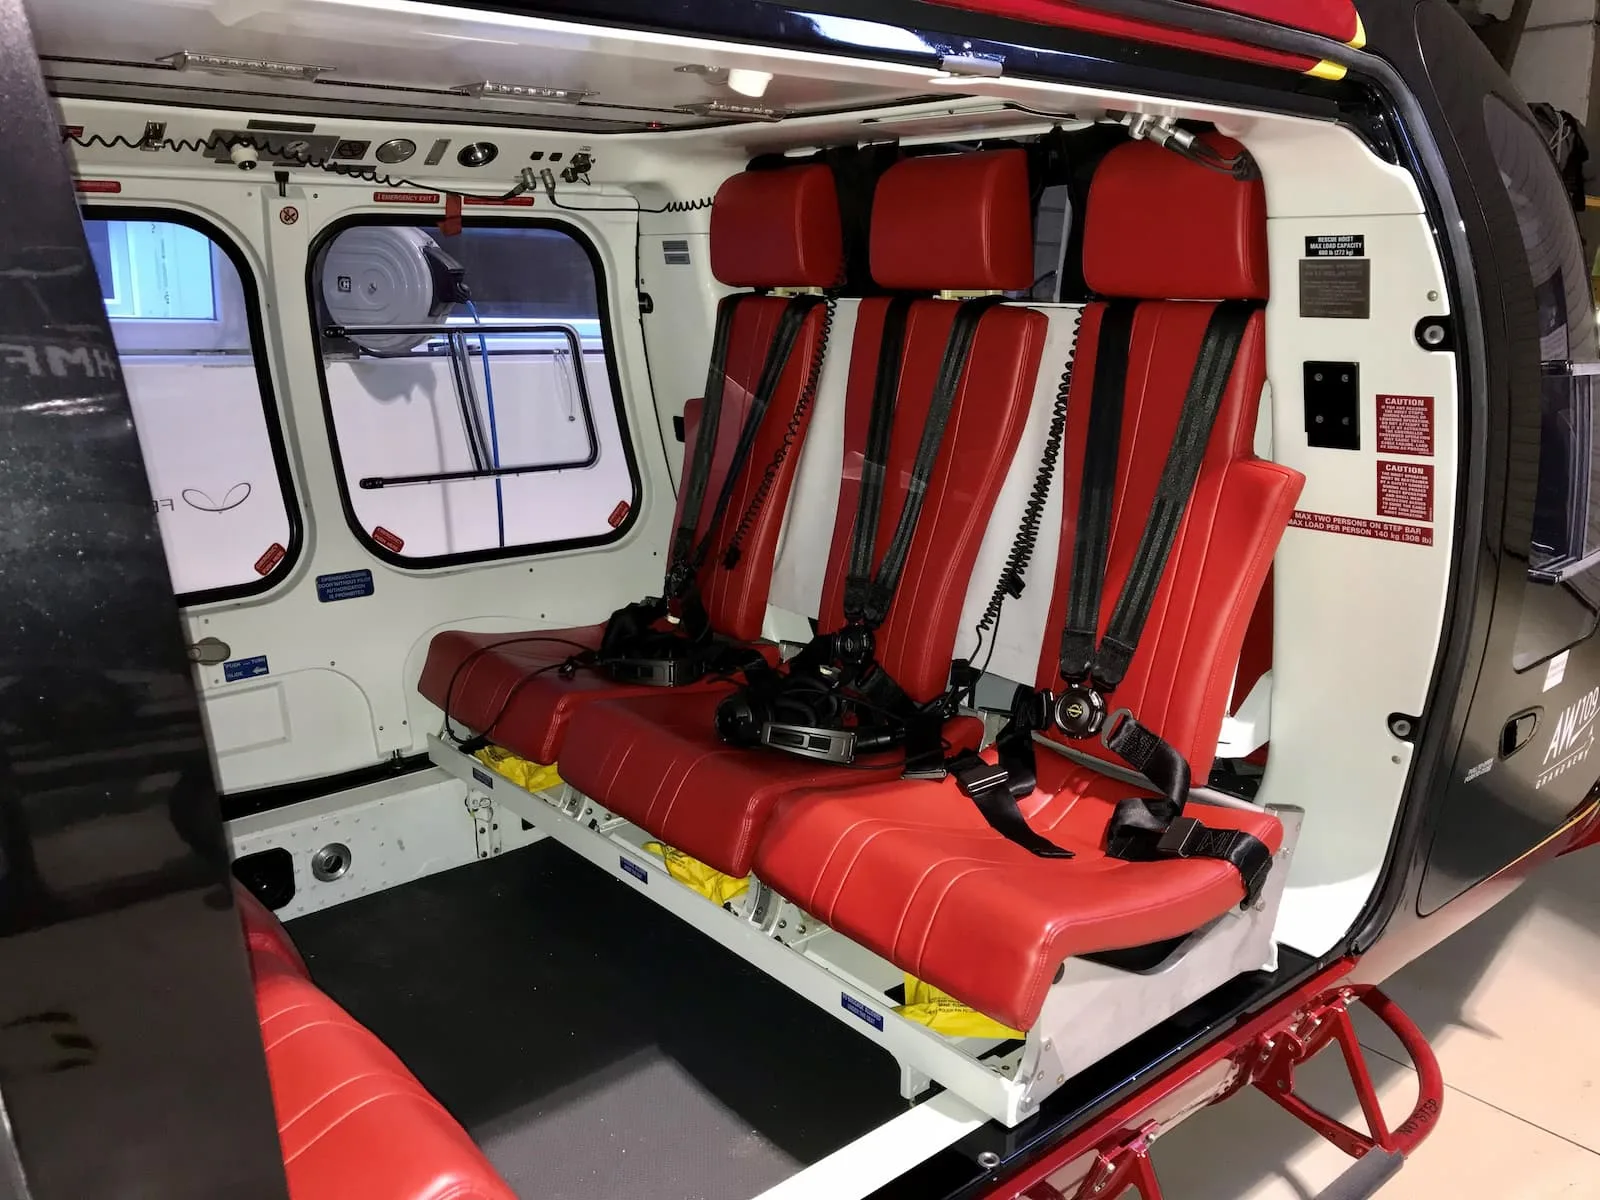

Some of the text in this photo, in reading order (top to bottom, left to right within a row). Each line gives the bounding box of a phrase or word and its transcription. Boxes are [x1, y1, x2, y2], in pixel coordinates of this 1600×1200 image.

[1385, 398, 1424, 406] CAUTION
[1386, 464, 1424, 474] CAUTION
[1294, 511, 1422, 535] MAX TWO PERSONS ON STEP BAR
[1305, 520, 1325, 529] LOAD
[1326, 523, 1340, 532] PER
[1342, 525, 1372, 536] PERSON
[1374, 530, 1388, 538] 140
[1391, 531, 1400, 541] kg
[1402, 533, 1420, 543] (308
[1422, 536, 1432, 544] lb)
[1399, 1098, 1439, 1134] NO STEP
